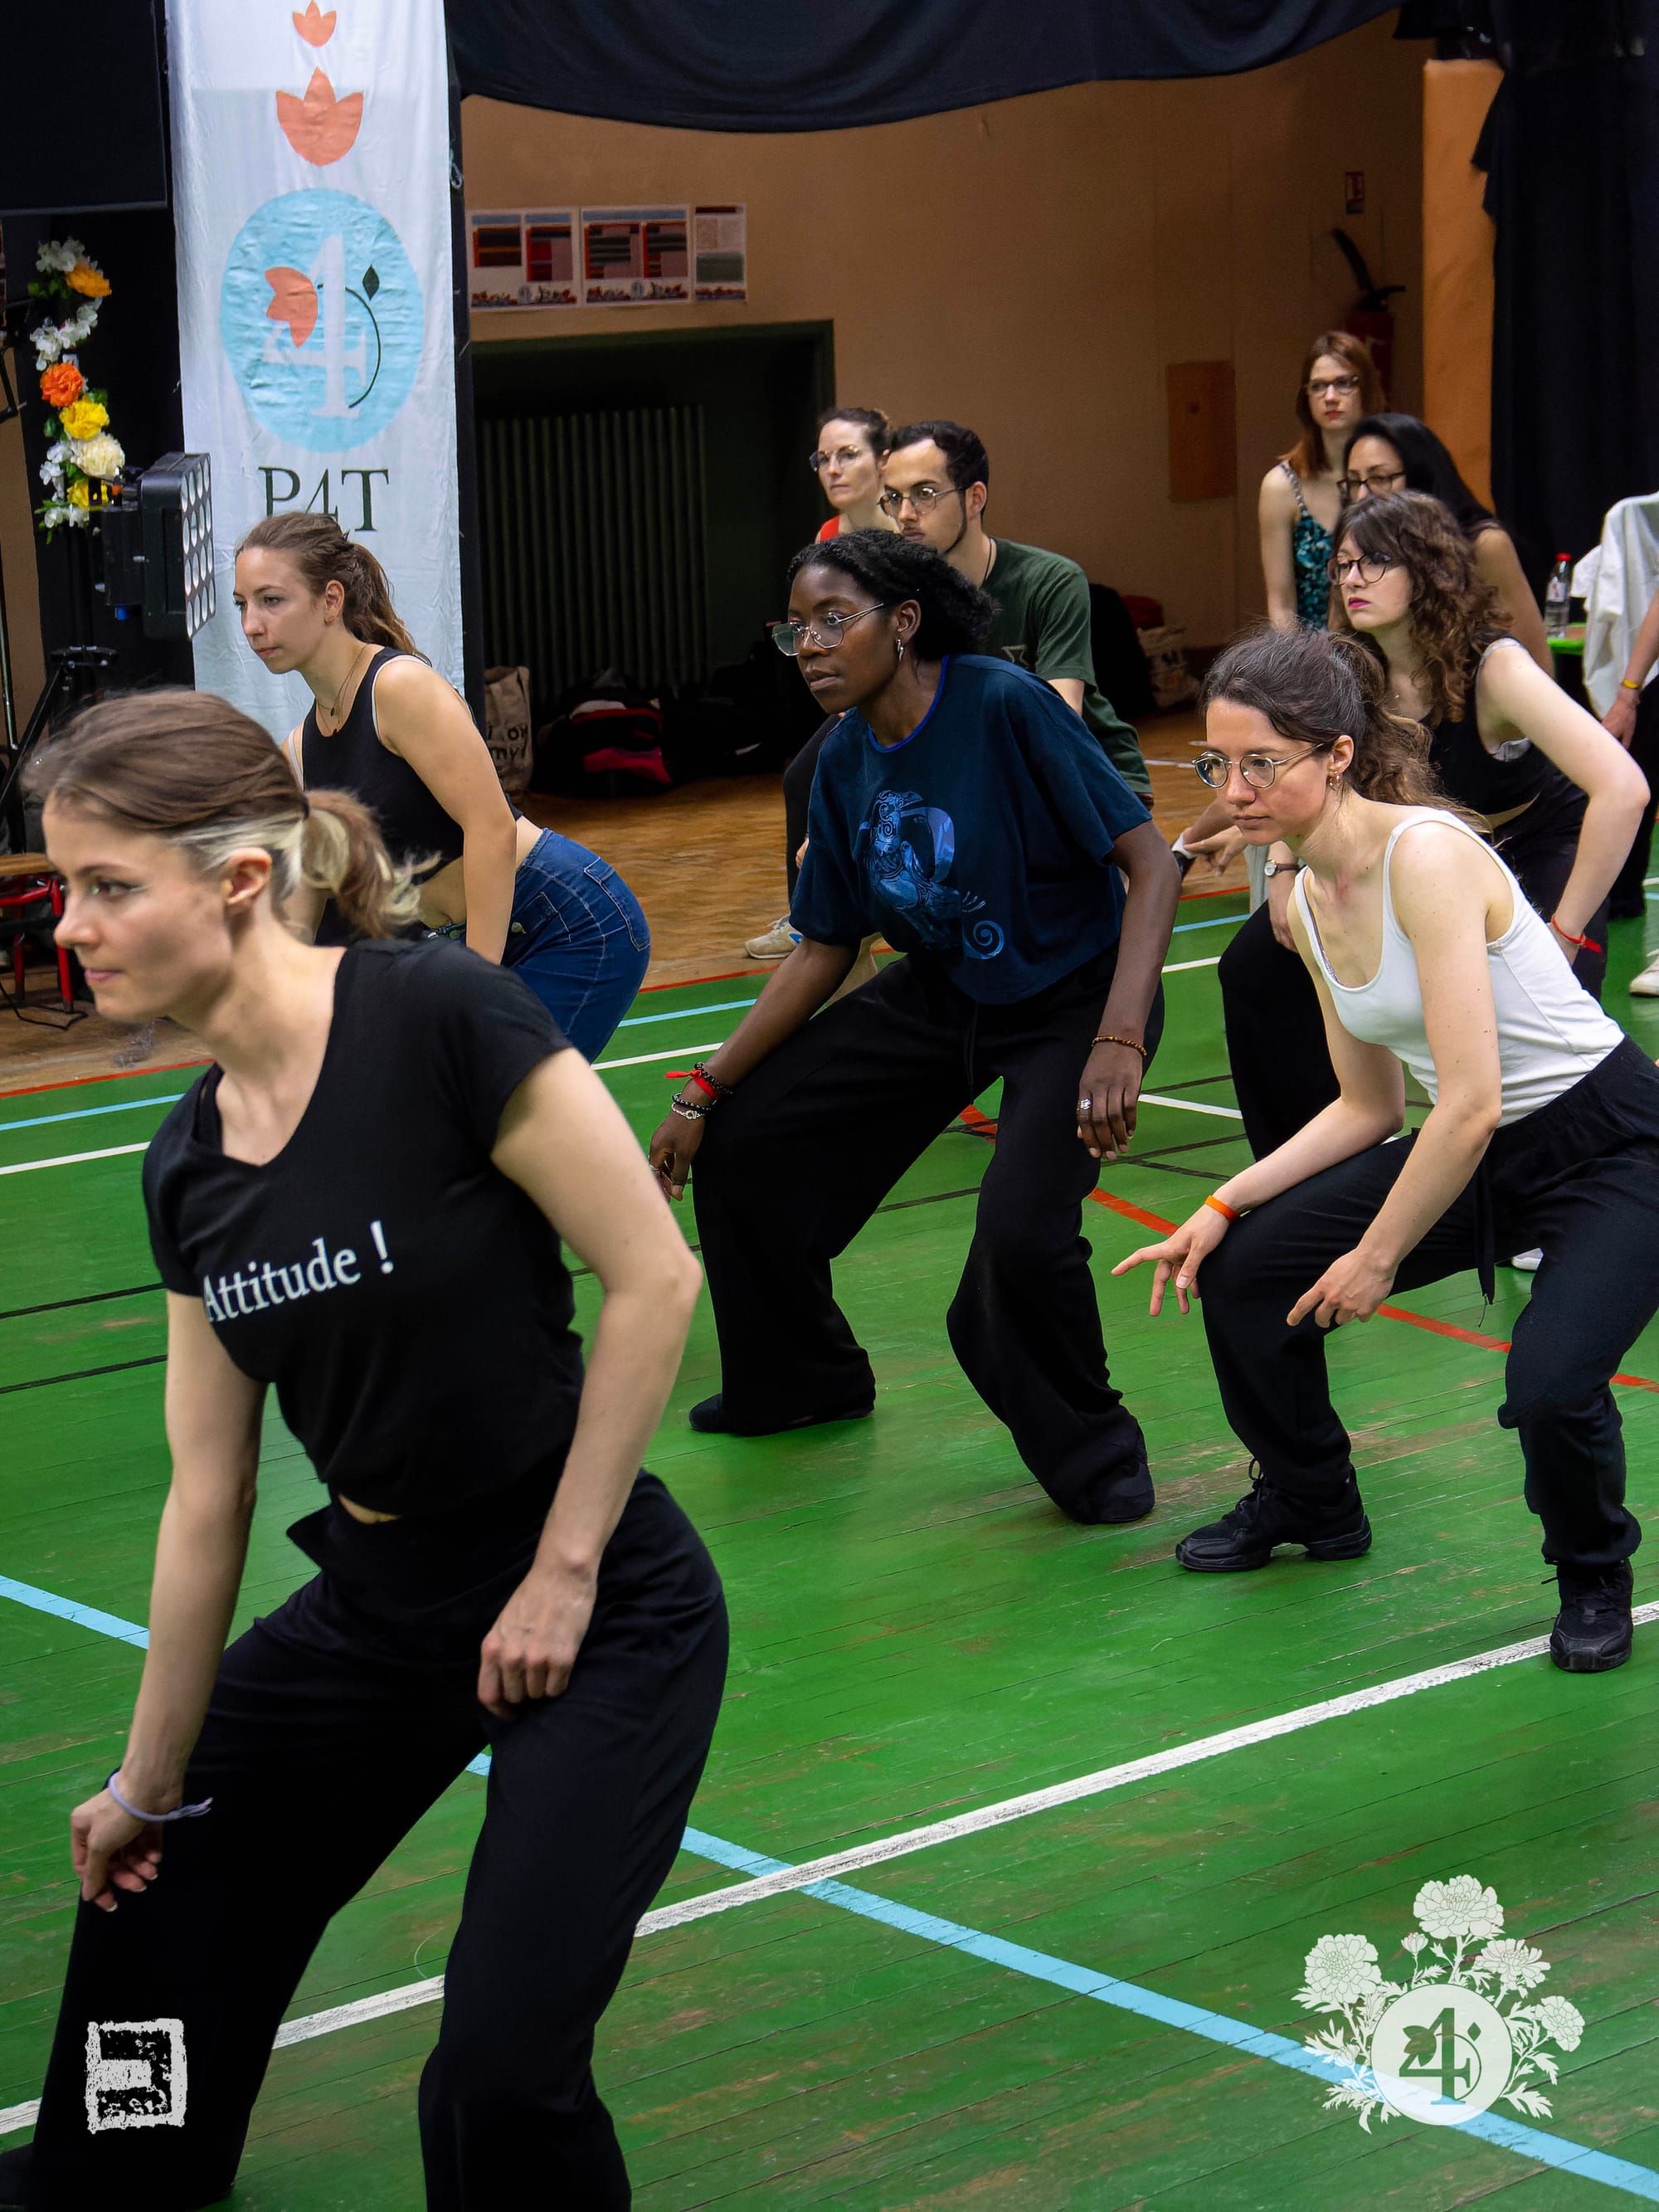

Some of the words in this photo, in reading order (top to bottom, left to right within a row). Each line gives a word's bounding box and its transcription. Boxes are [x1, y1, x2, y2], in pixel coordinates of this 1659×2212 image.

[258, 465, 389, 532] P4T
[202, 1236, 362, 1323] Attitude
[370, 1220, 394, 1274] !
